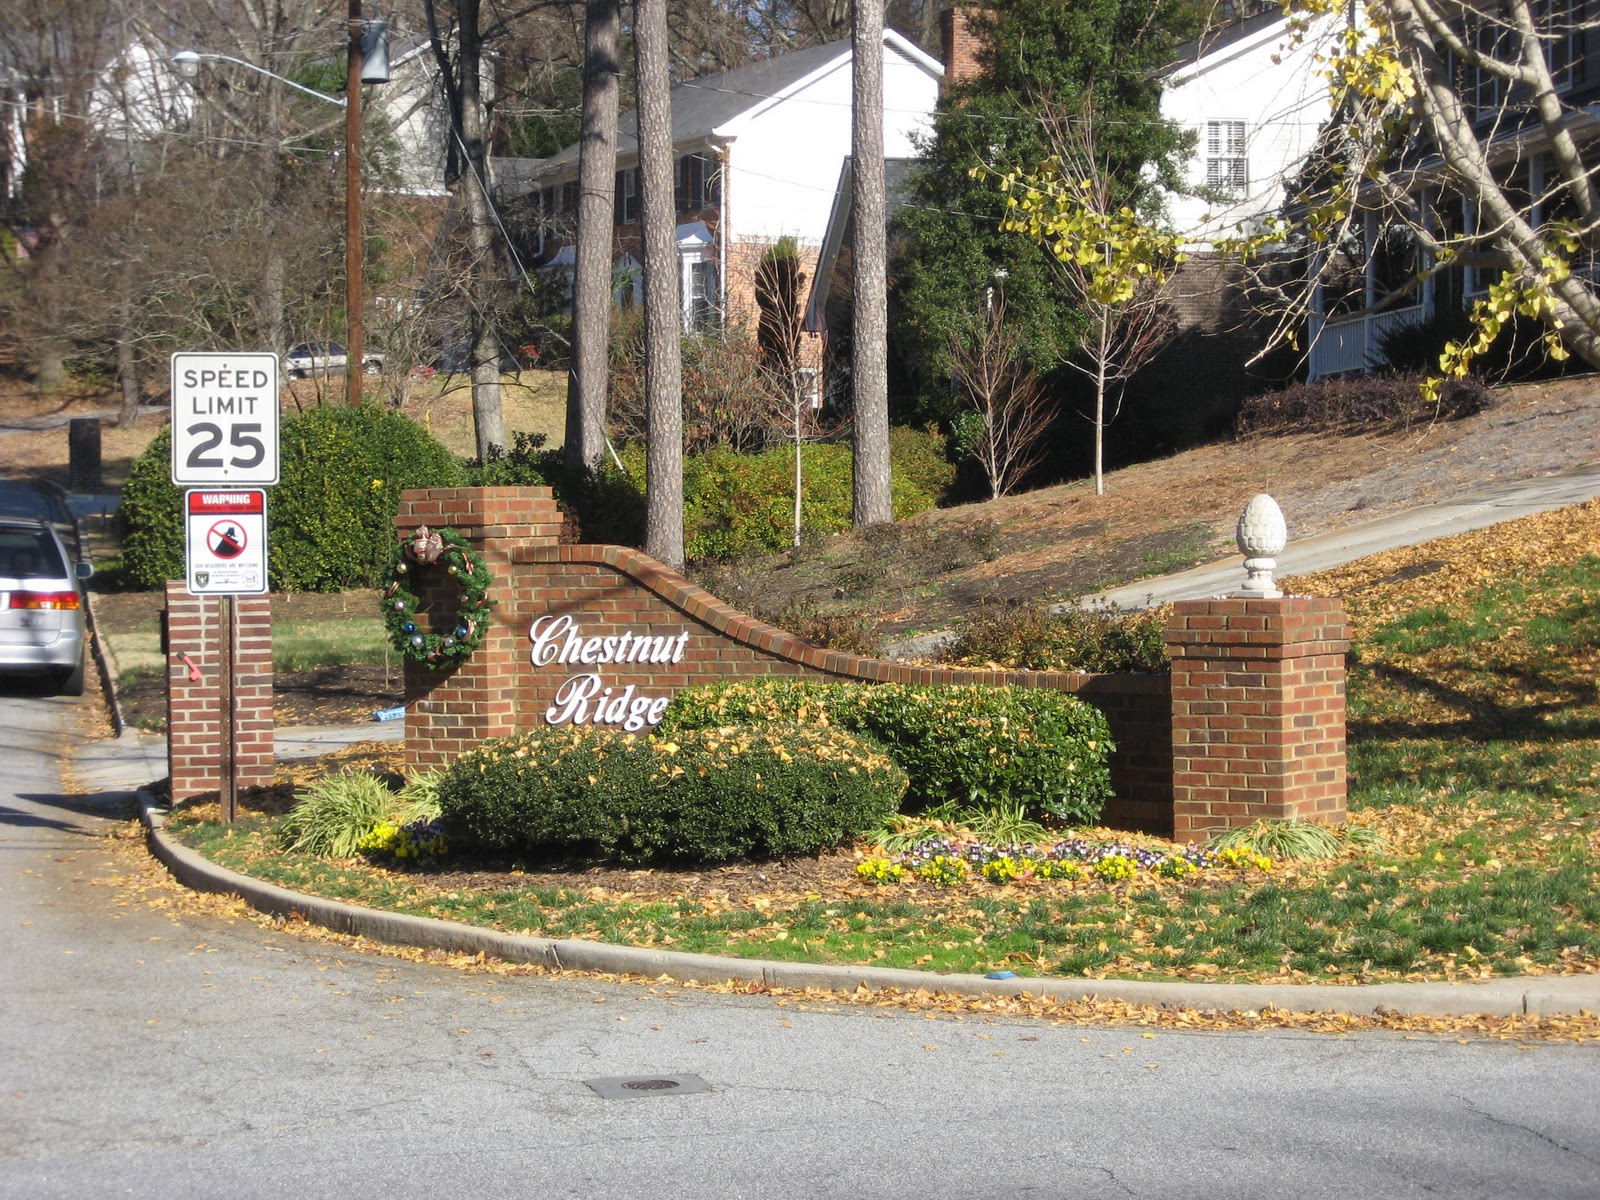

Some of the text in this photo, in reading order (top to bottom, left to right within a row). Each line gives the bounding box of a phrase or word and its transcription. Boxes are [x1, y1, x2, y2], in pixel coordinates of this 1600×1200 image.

[183, 370, 267, 388] SPEED
[193, 397, 258, 415] LIMIT
[186, 422, 266, 469] 25
[202, 494, 251, 504] WARNING
[529, 614, 689, 667] Chestnut
[545, 673, 669, 732] Ridge
